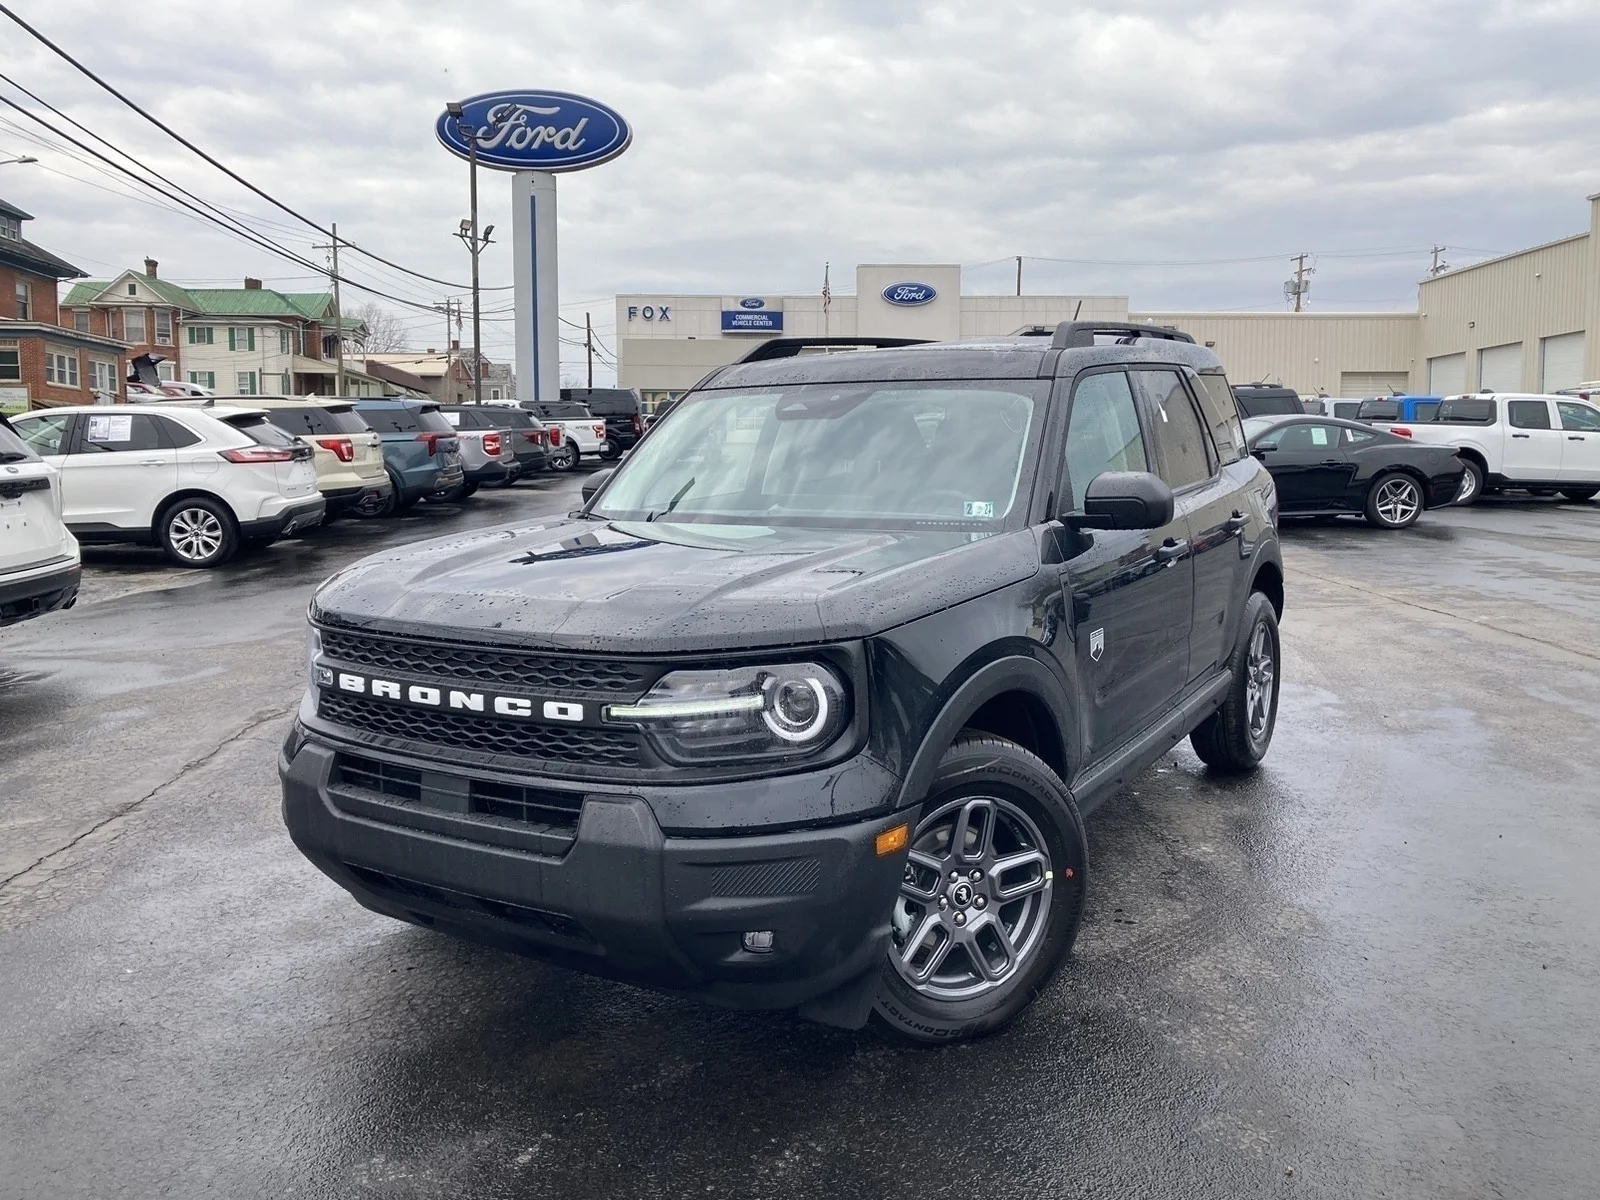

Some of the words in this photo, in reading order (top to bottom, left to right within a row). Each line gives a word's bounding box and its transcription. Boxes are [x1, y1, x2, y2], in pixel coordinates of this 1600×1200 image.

[464, 103, 589, 151] Ford
[894, 286, 926, 300] Ford
[627, 306, 671, 320] FOX
[338, 673, 584, 722] BRONCO
